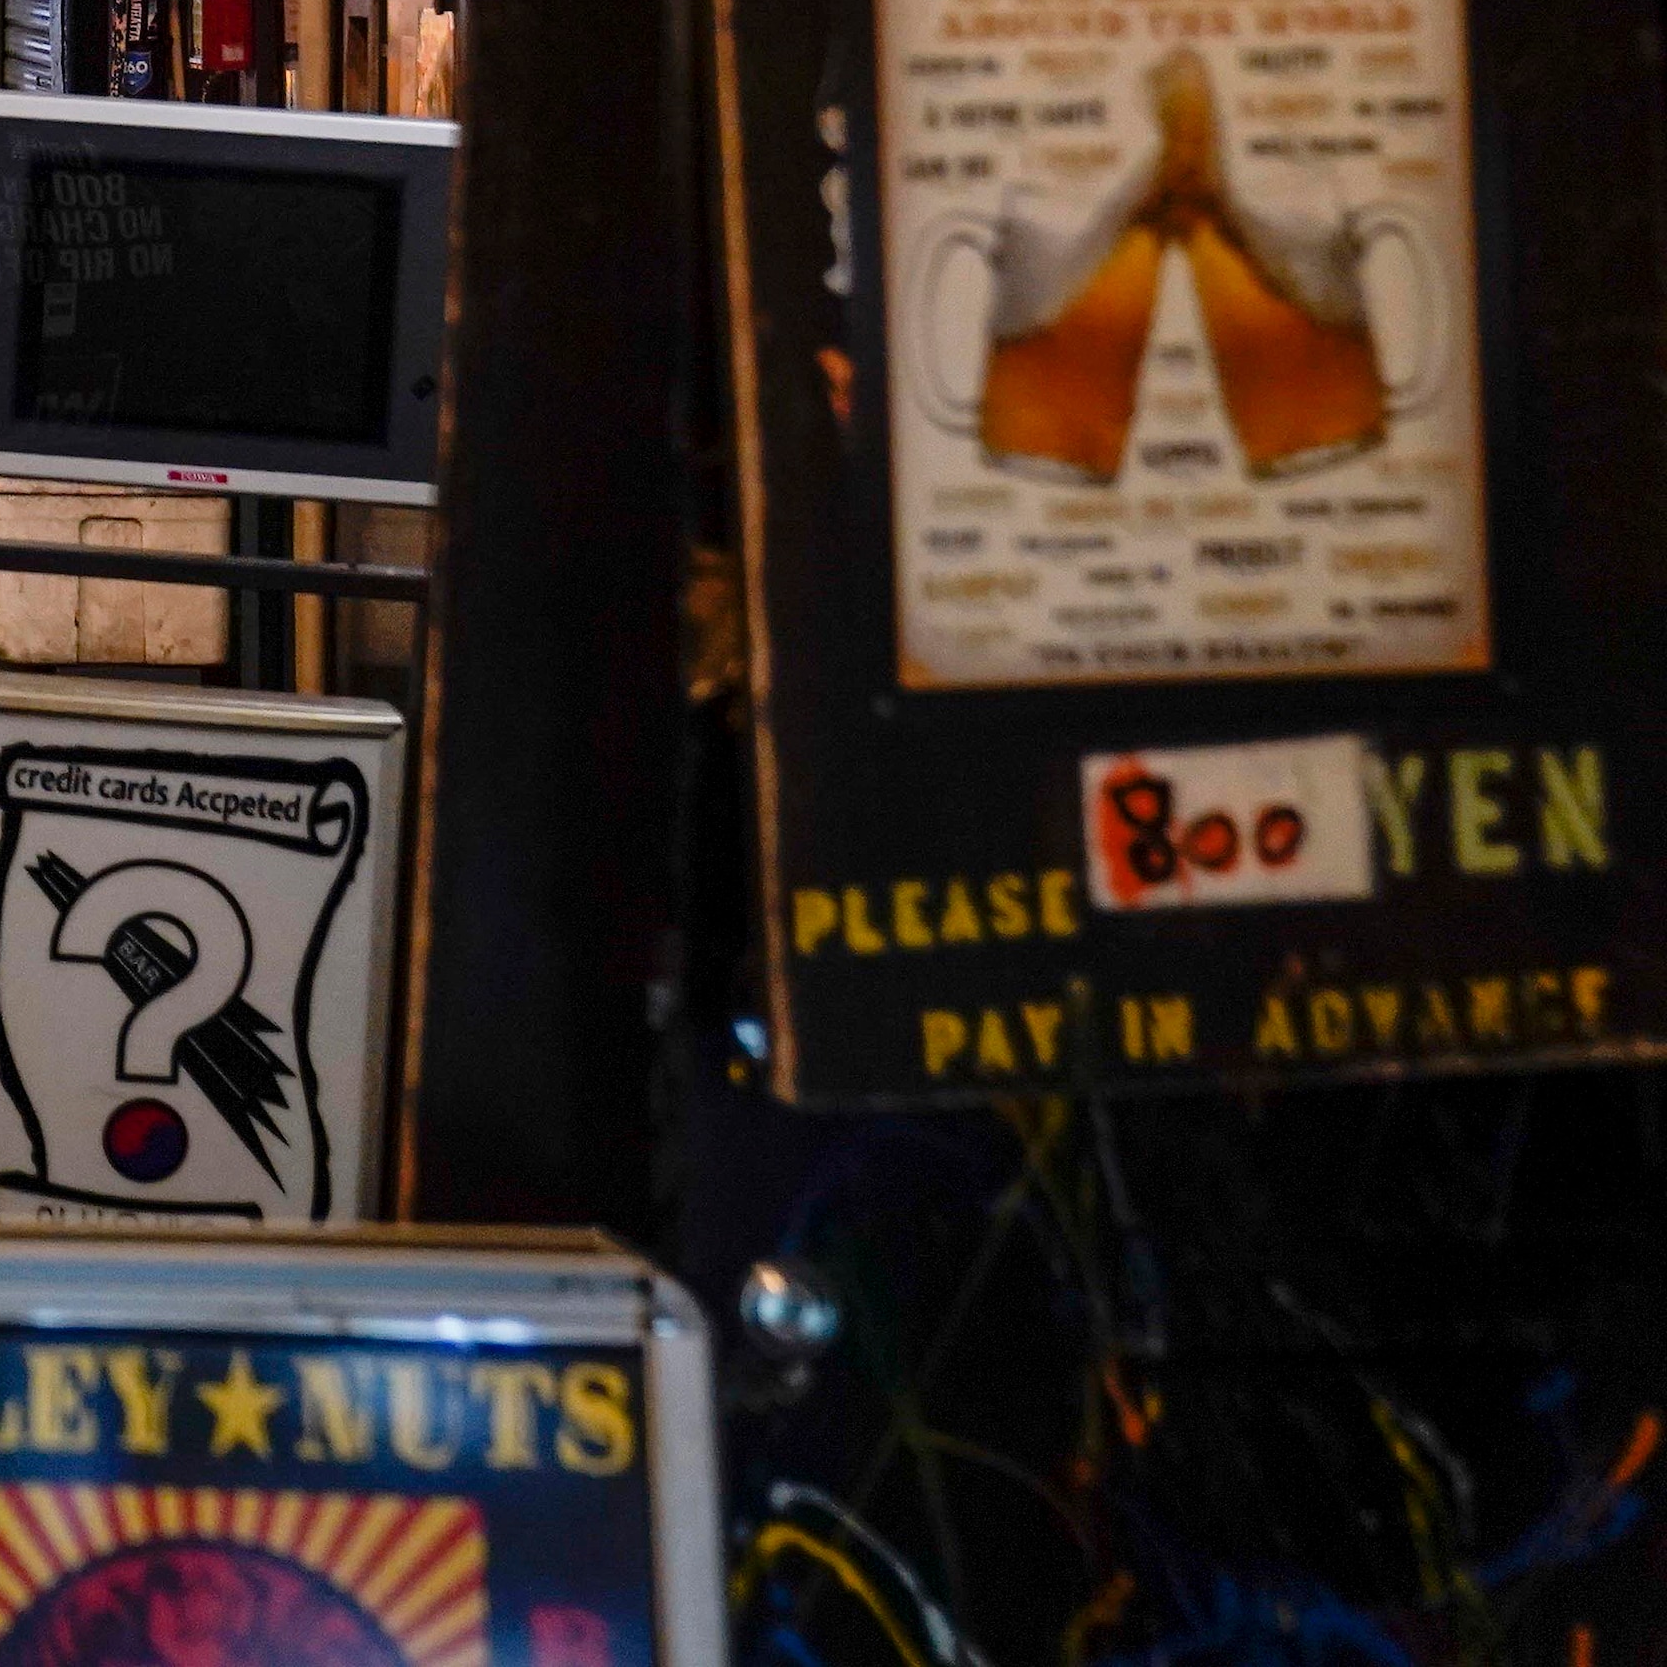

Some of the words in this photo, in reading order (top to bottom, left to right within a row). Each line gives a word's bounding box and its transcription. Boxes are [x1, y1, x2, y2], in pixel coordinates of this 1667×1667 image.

[12, 765, 91, 797] credit
[98, 775, 169, 806] cards
[1365, 747, 1607, 876] YEN
[793, 870, 1079, 956] PLEASE
[922, 1002, 1064, 1077] PAY
[1121, 994, 1193, 1065] IN
[298, 1349, 637, 1477] NUTS
